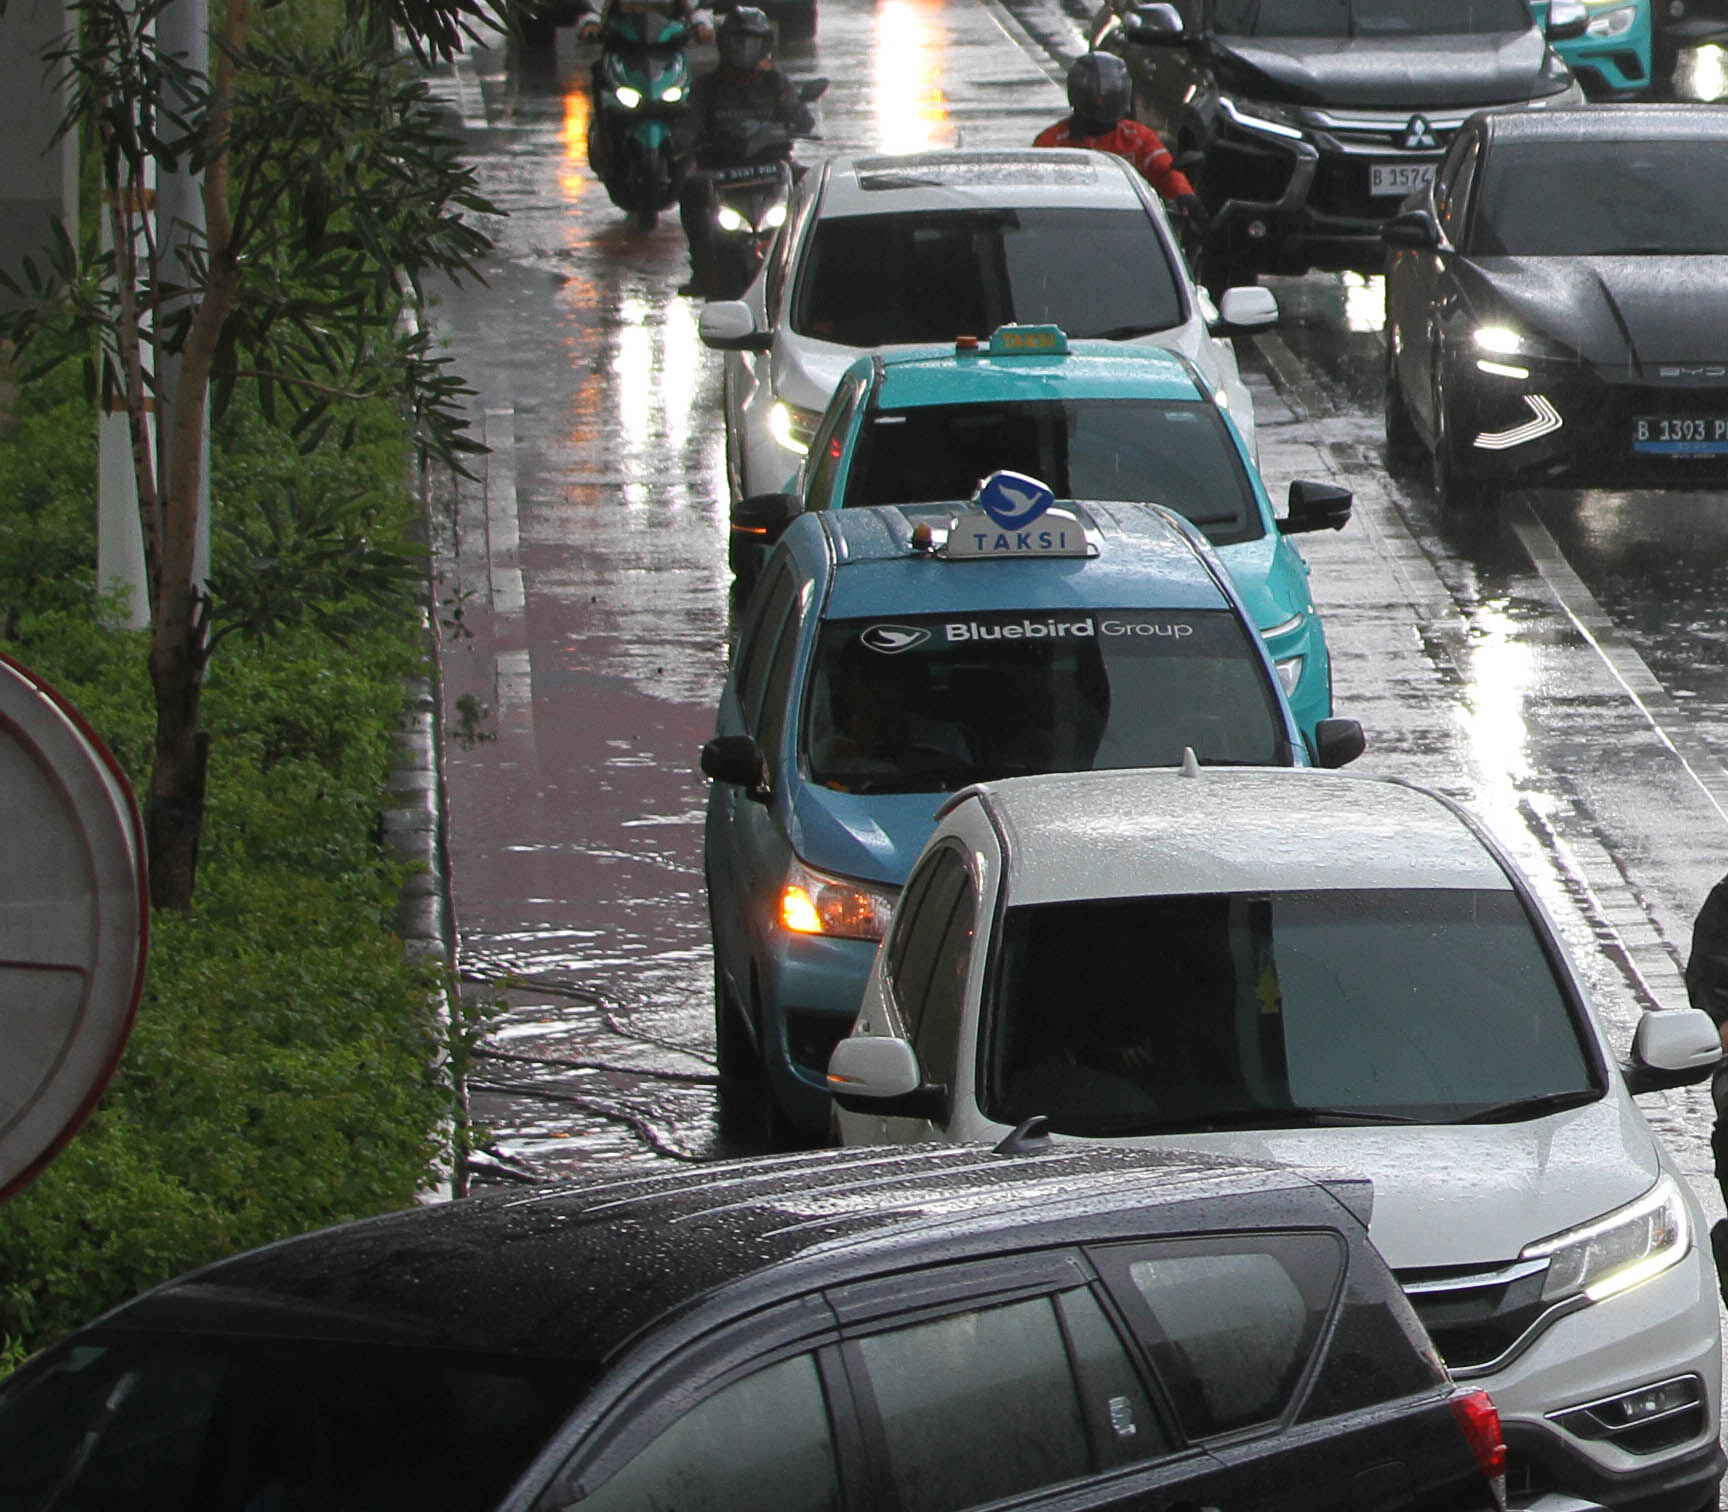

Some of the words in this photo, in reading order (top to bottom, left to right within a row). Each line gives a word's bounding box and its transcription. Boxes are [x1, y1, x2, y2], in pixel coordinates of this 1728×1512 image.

[1373, 169, 1383, 186] B
[1002, 333, 1056, 348] TAKSI
[1659, 367, 1726, 377] BYD
[1637, 420, 1649, 441] B
[1660, 419, 1706, 441] 1393
[973, 531, 1066, 551] TAKSI
[945, 618, 1095, 641] Bluebird
[1101, 620, 1193, 640] Group
